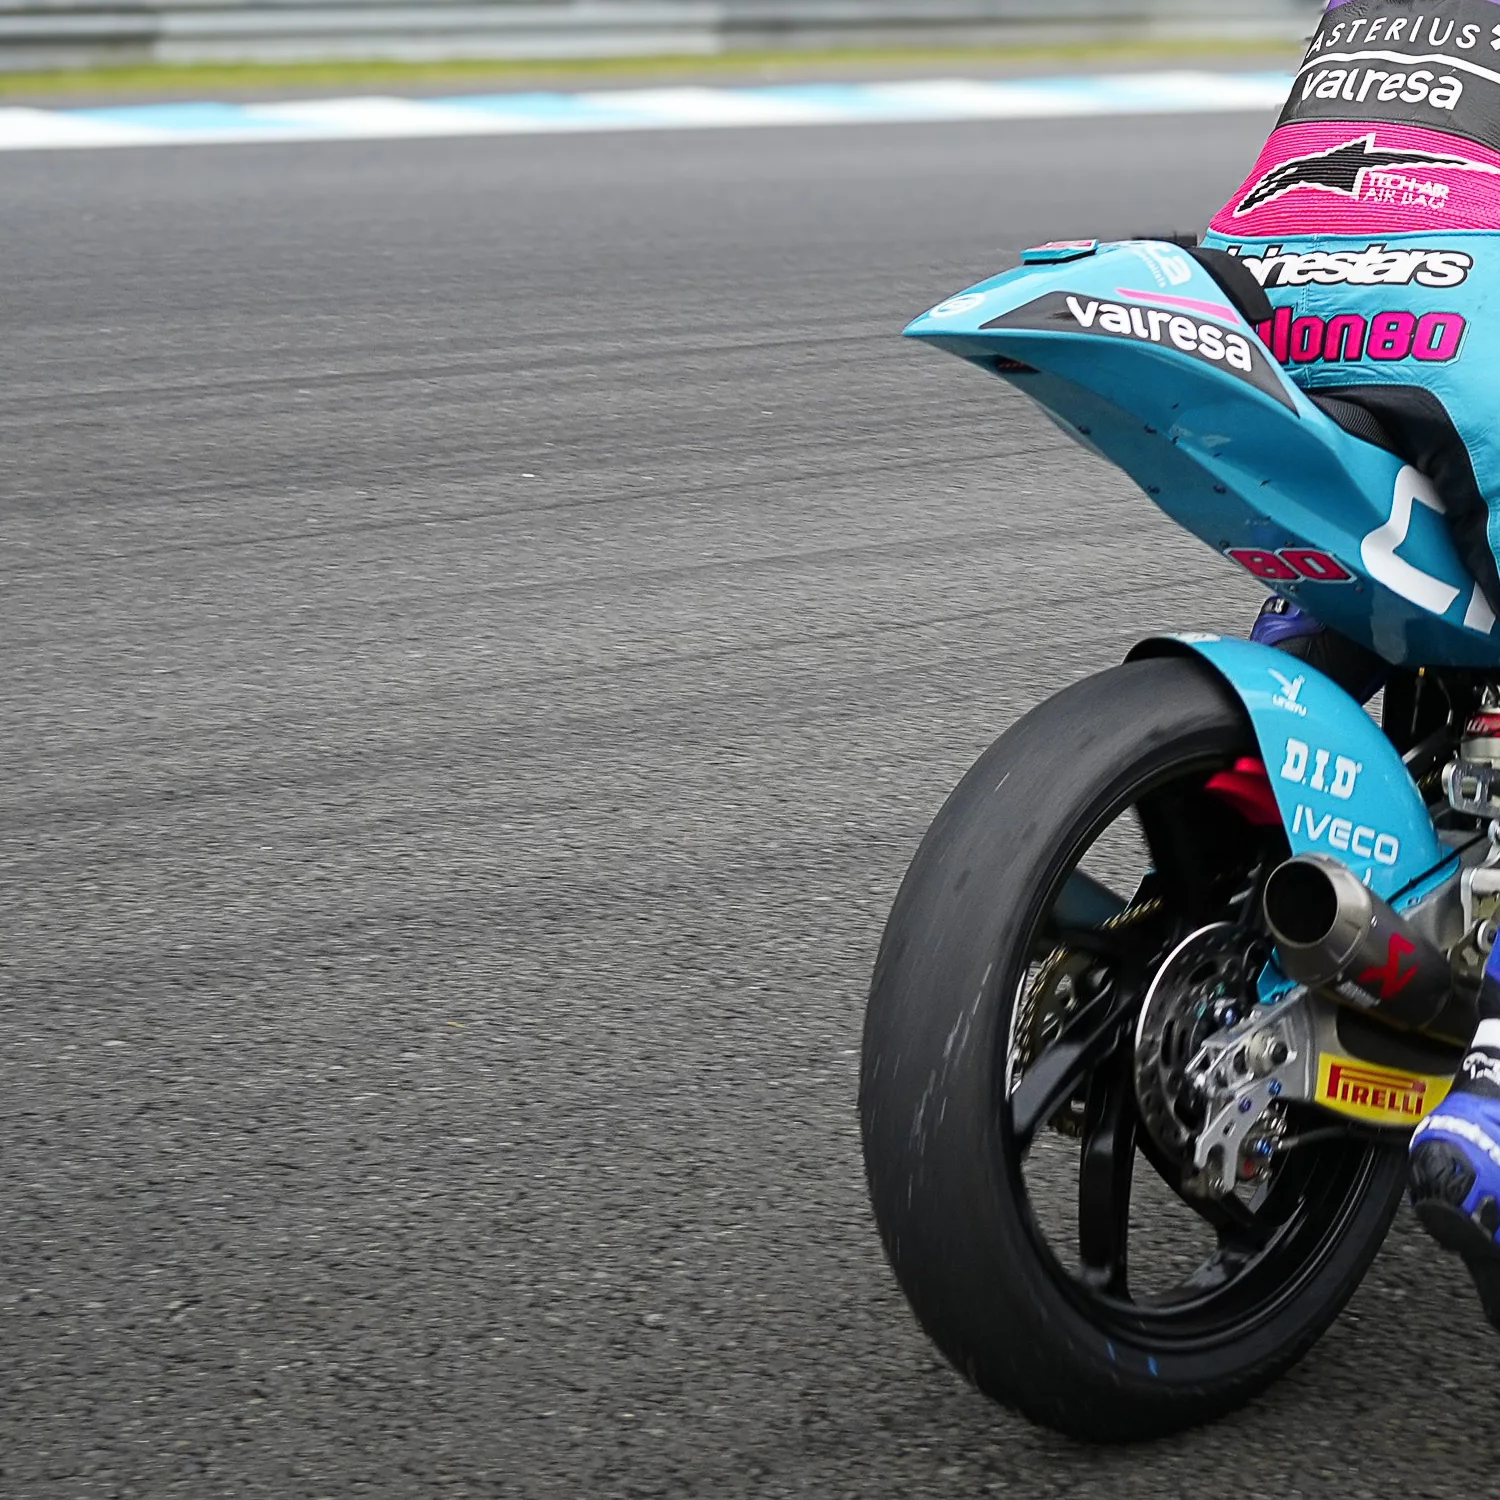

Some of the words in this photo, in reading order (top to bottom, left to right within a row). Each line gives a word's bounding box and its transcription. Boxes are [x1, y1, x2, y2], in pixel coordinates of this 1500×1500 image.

[1305, 15, 1481, 59] ASTERIUS
[1301, 67, 1464, 111] valresa
[1226, 243, 1474, 288] inestars
[1065, 296, 1253, 373] valresa
[1223, 547, 1358, 583] 80
[1280, 737, 1358, 800] D.I.D
[1291, 803, 1400, 866] IVECO
[1326, 1062, 1427, 1116] PIRELLI
